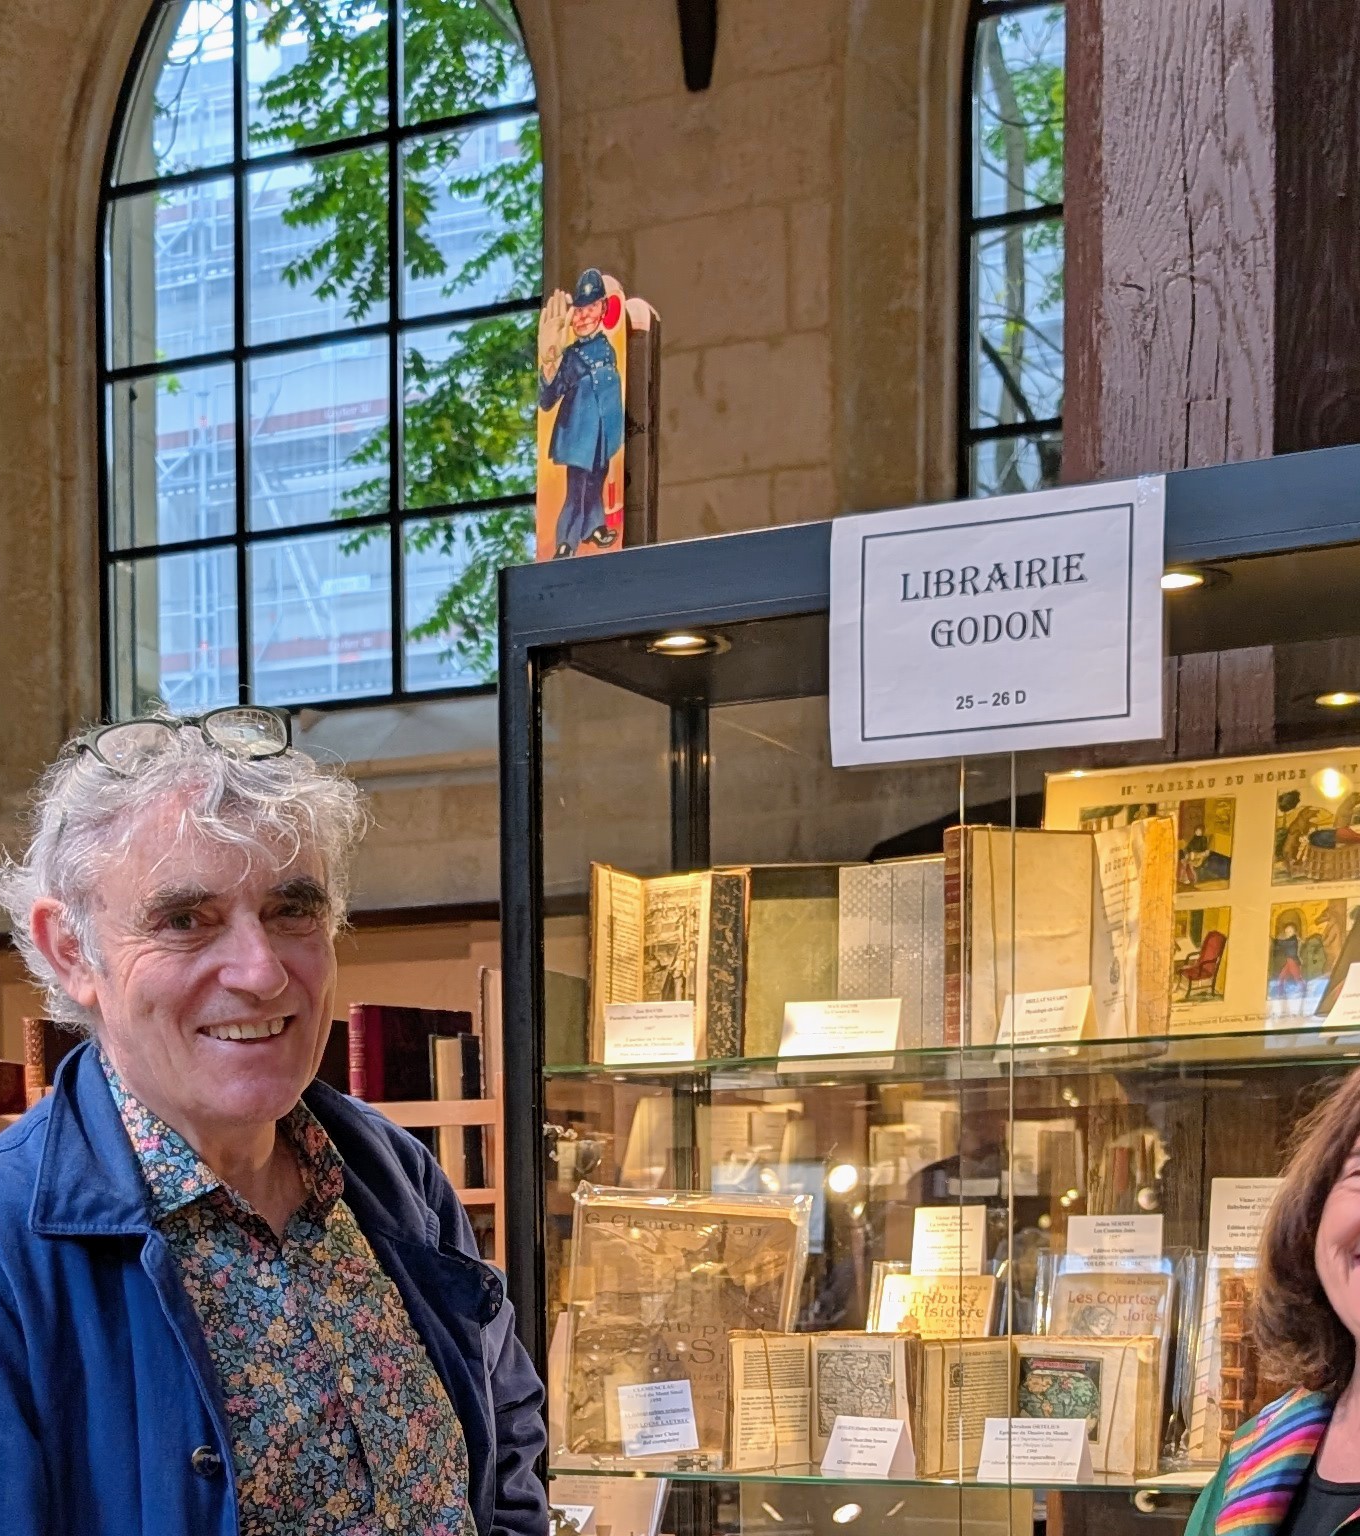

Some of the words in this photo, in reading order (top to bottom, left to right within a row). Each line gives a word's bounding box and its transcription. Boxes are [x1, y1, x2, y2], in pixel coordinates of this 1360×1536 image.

[900, 553, 1087, 602] LIBRAIRIE
[931, 608, 1053, 648] GODON
[956, 695, 975, 710] 25
[992, 692, 1010, 707] 26
[1015, 691, 1026, 705] D
[1146, 778, 1216, 794] TABLEAU
[1225, 776, 1244, 786] DU
[1253, 769, 1306, 783] MONDE
[1068, 1291, 1092, 1304] Les
[1097, 1292, 1157, 1305] Courtes
[1123, 1308, 1160, 1321] Joies
